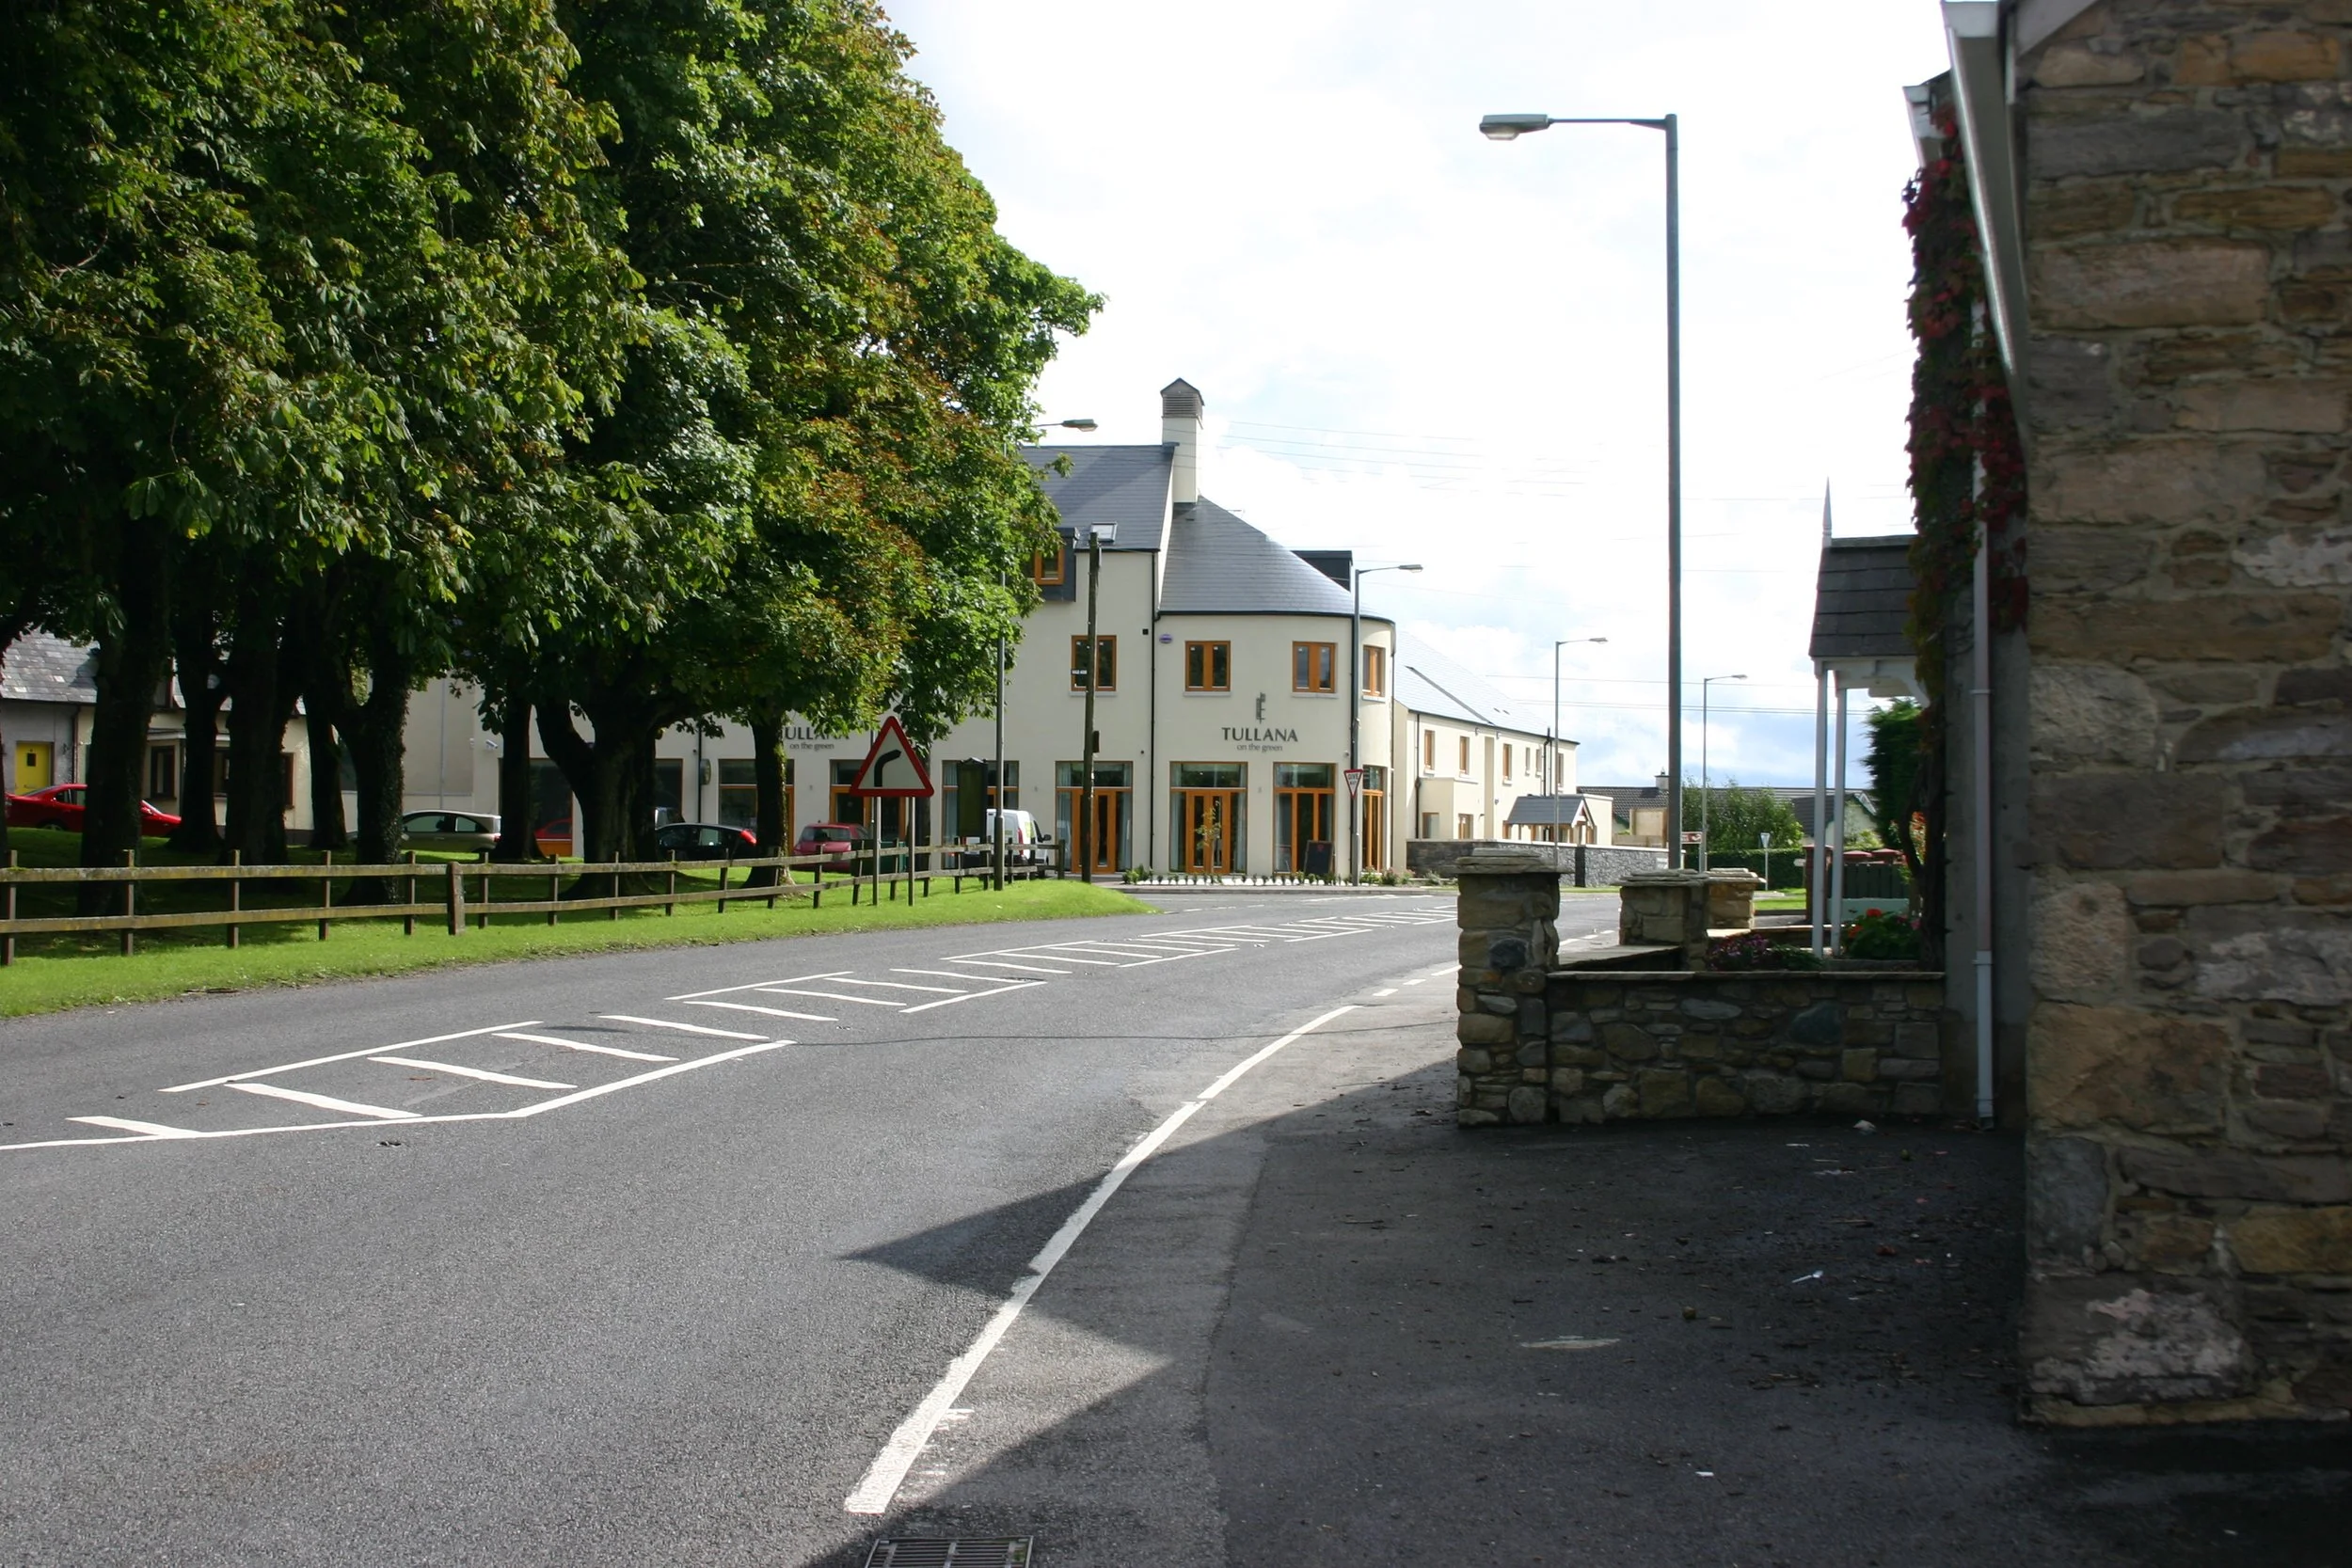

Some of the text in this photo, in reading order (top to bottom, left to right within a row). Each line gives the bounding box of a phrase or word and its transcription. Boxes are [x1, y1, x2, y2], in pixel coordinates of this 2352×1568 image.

[1221, 727, 1298, 742] TULLANA
[801, 741, 813, 750] the
[814, 743, 835, 752] green
[1248, 742, 1261, 752] the
[1262, 744, 1283, 753] green
